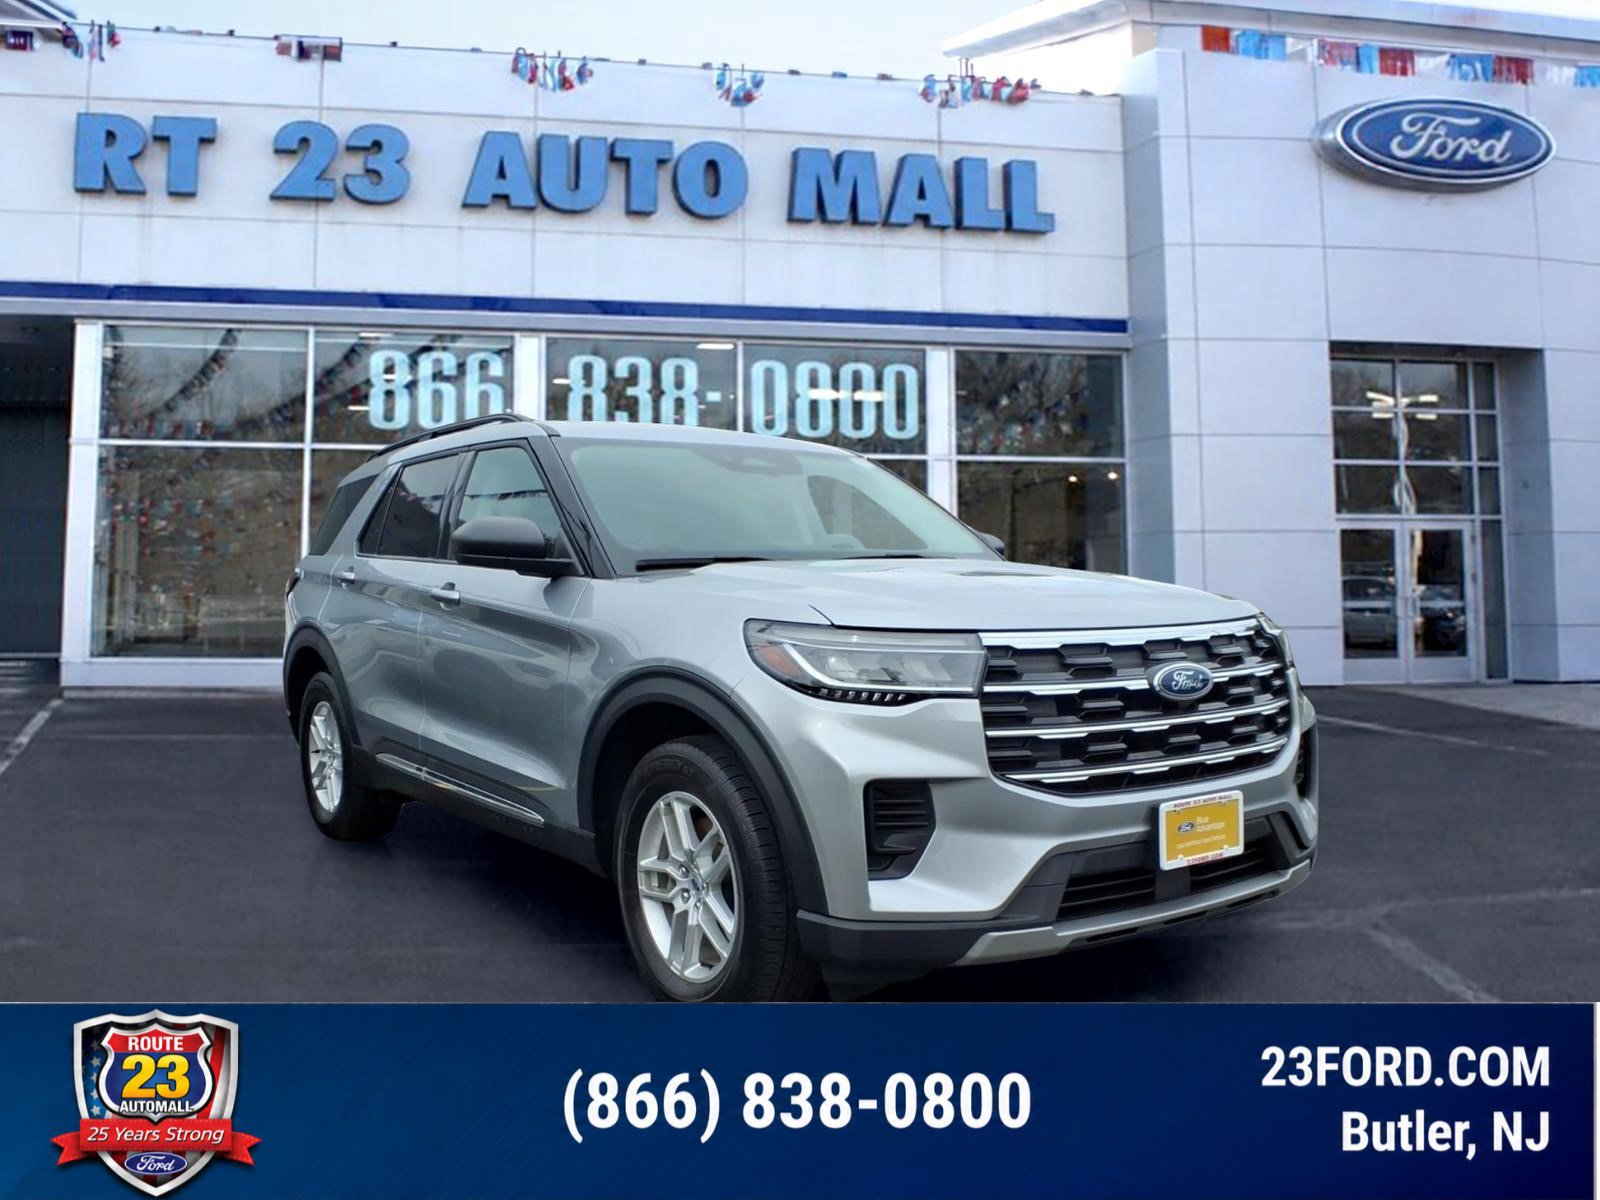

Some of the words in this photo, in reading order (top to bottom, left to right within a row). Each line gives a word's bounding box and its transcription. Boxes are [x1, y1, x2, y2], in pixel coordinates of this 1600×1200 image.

[73, 111, 219, 197] RT
[271, 119, 414, 204] 23
[461, 130, 751, 220] AUTO
[788, 145, 1058, 235] MALL
[1390, 112, 1512, 163] Ford
[369, 350, 504, 430] 866
